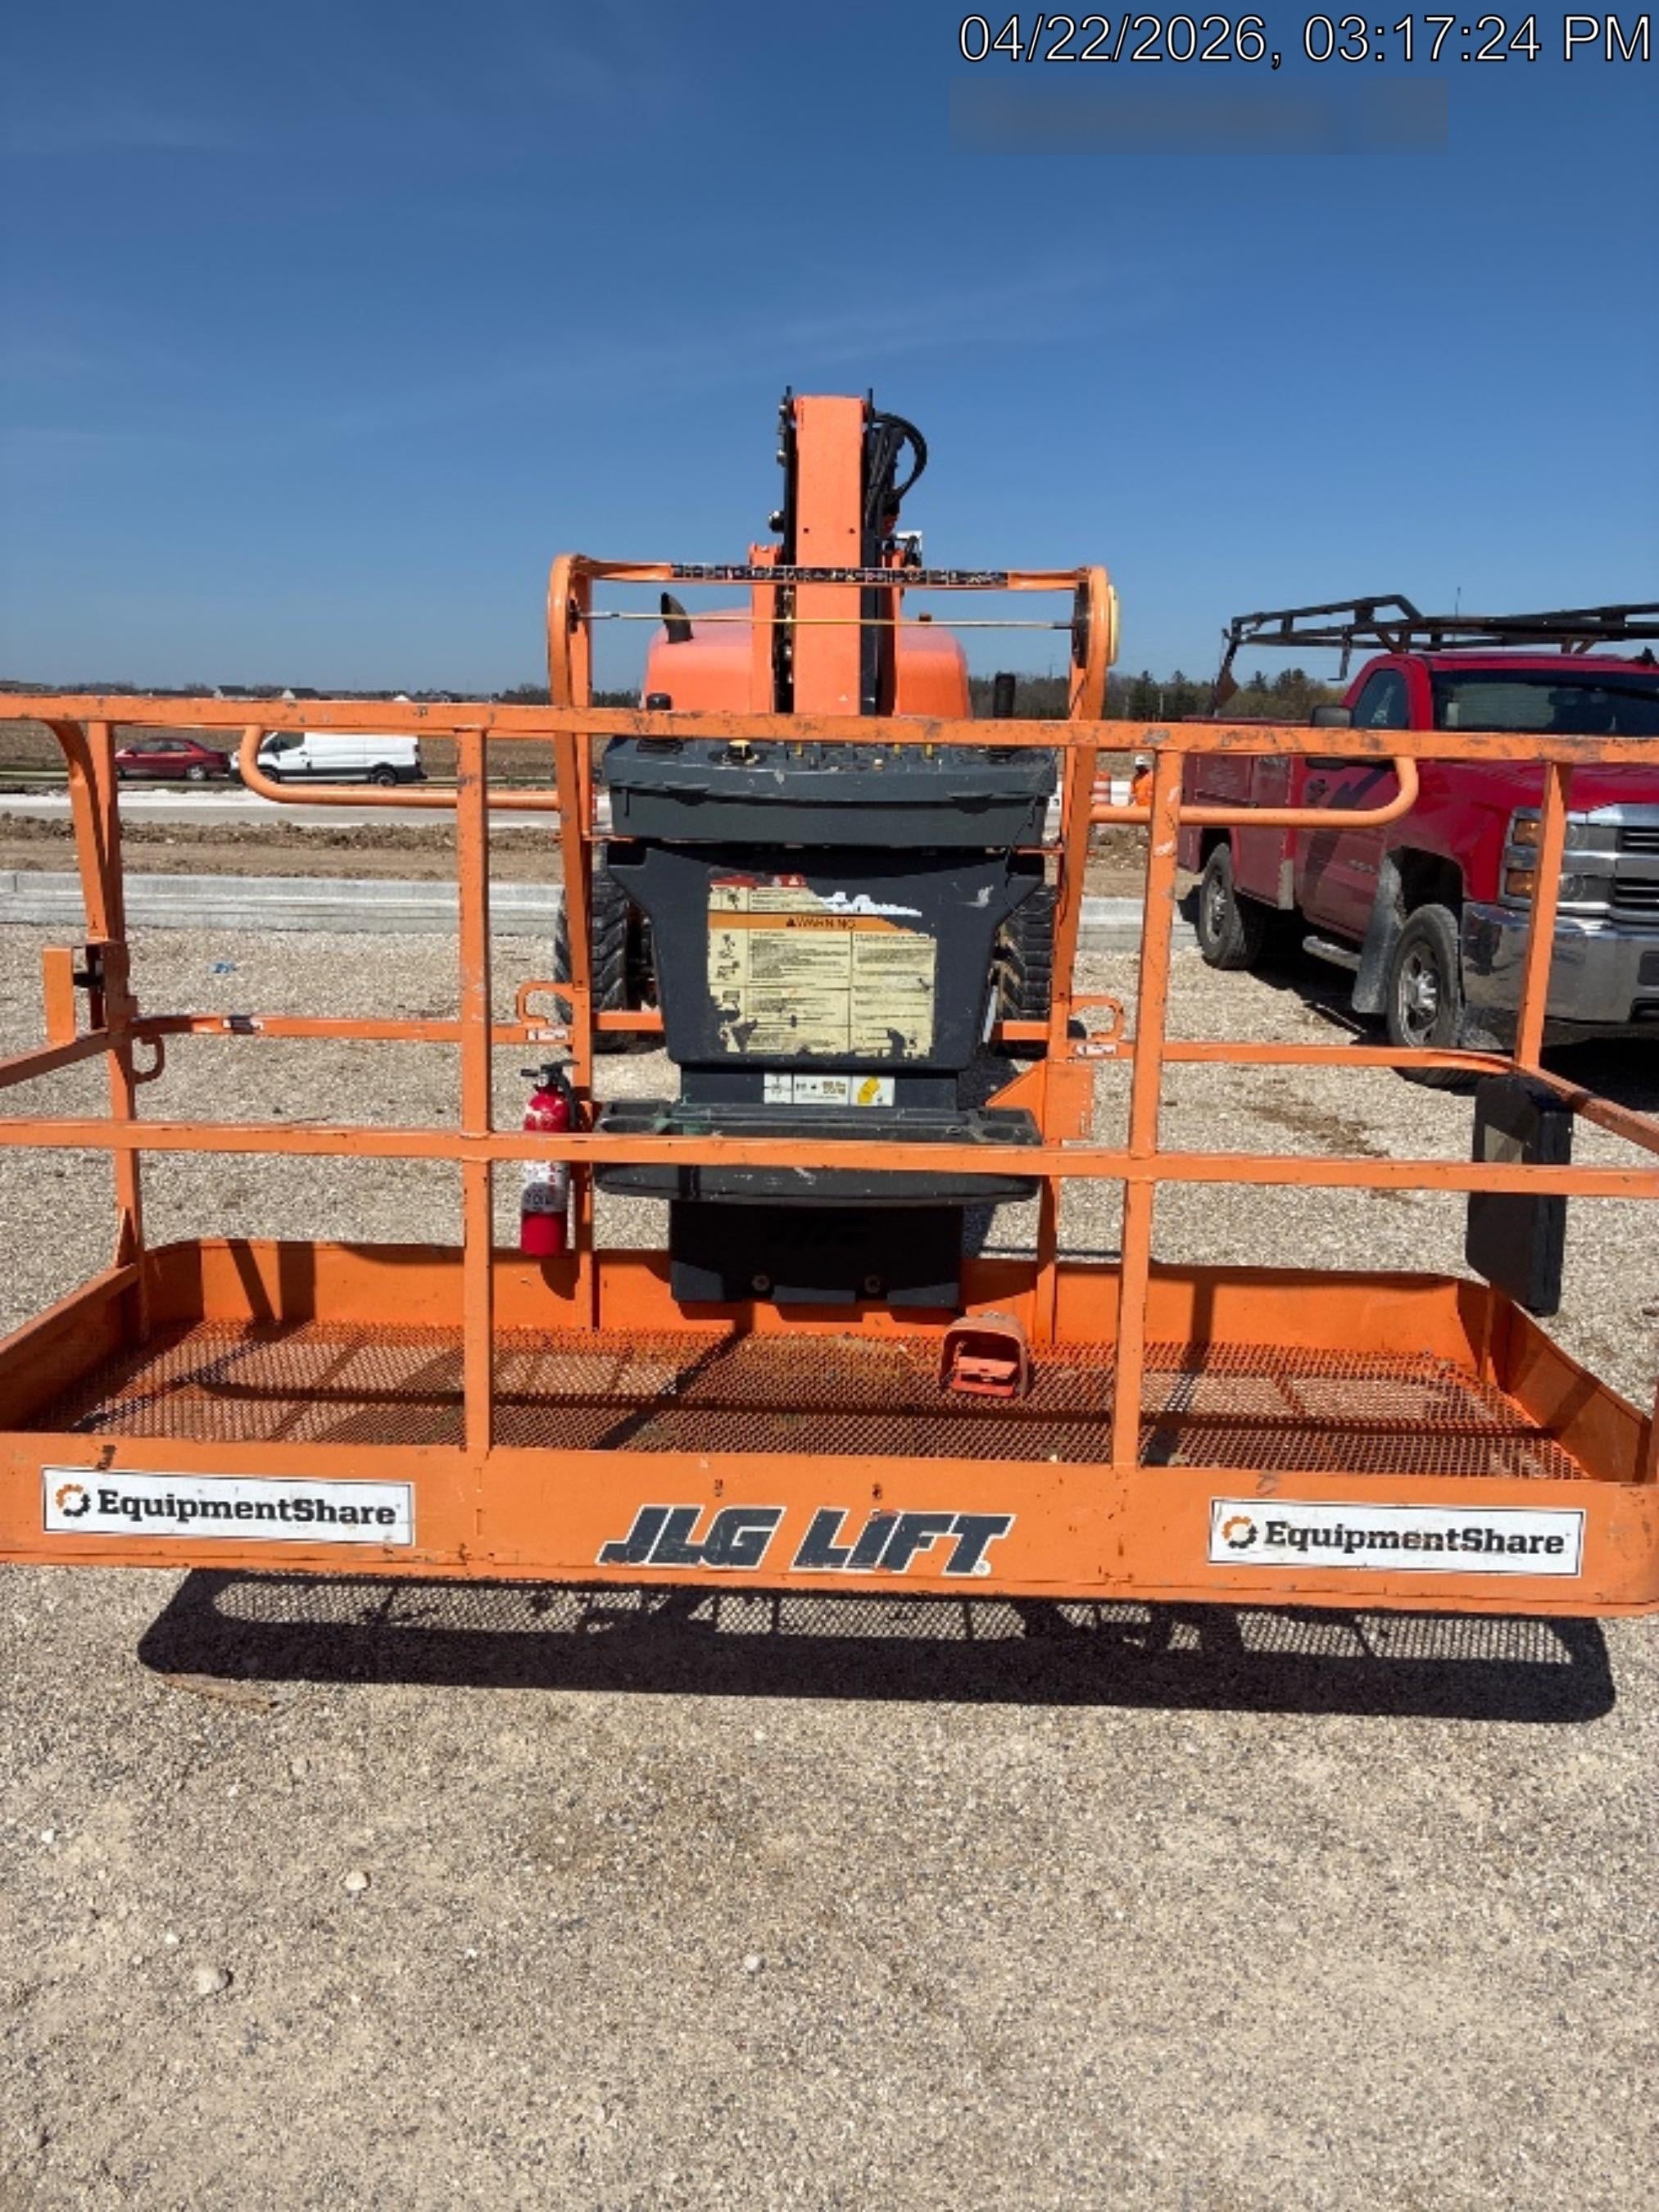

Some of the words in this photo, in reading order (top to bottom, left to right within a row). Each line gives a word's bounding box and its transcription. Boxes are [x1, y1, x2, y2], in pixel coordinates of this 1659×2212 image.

[97, 1489, 396, 1525] EquipmentShare
[595, 1504, 786, 1572] JLG
[790, 1506, 1018, 1577] LIFT
[1264, 1521, 1565, 1555] EquipmentShare
